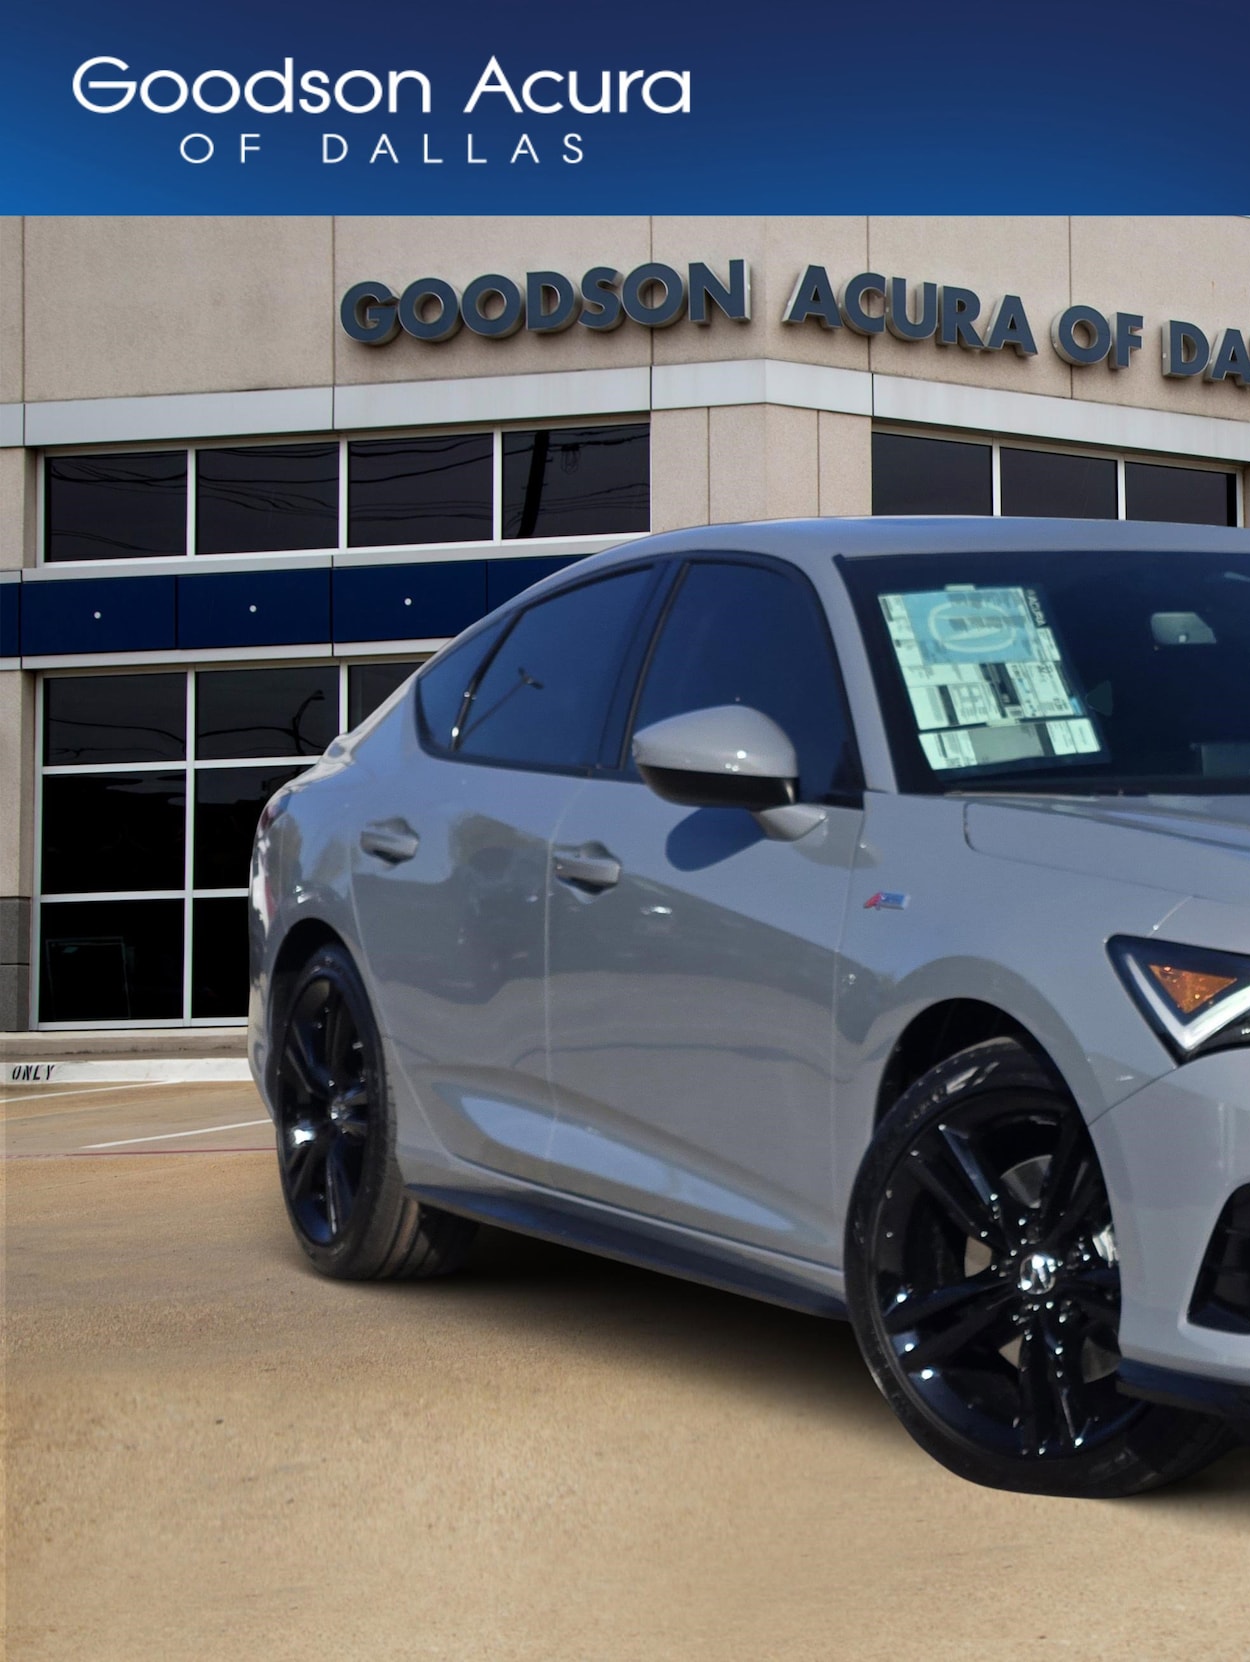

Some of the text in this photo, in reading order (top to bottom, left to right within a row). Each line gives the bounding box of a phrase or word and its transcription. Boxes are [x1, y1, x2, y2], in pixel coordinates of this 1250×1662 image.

[340, 258, 751, 345] GOODSON
[782, 264, 1037, 357] ACURA
[1052, 304, 1144, 367] OF
[12, 1064, 55, 1081] ONLY
